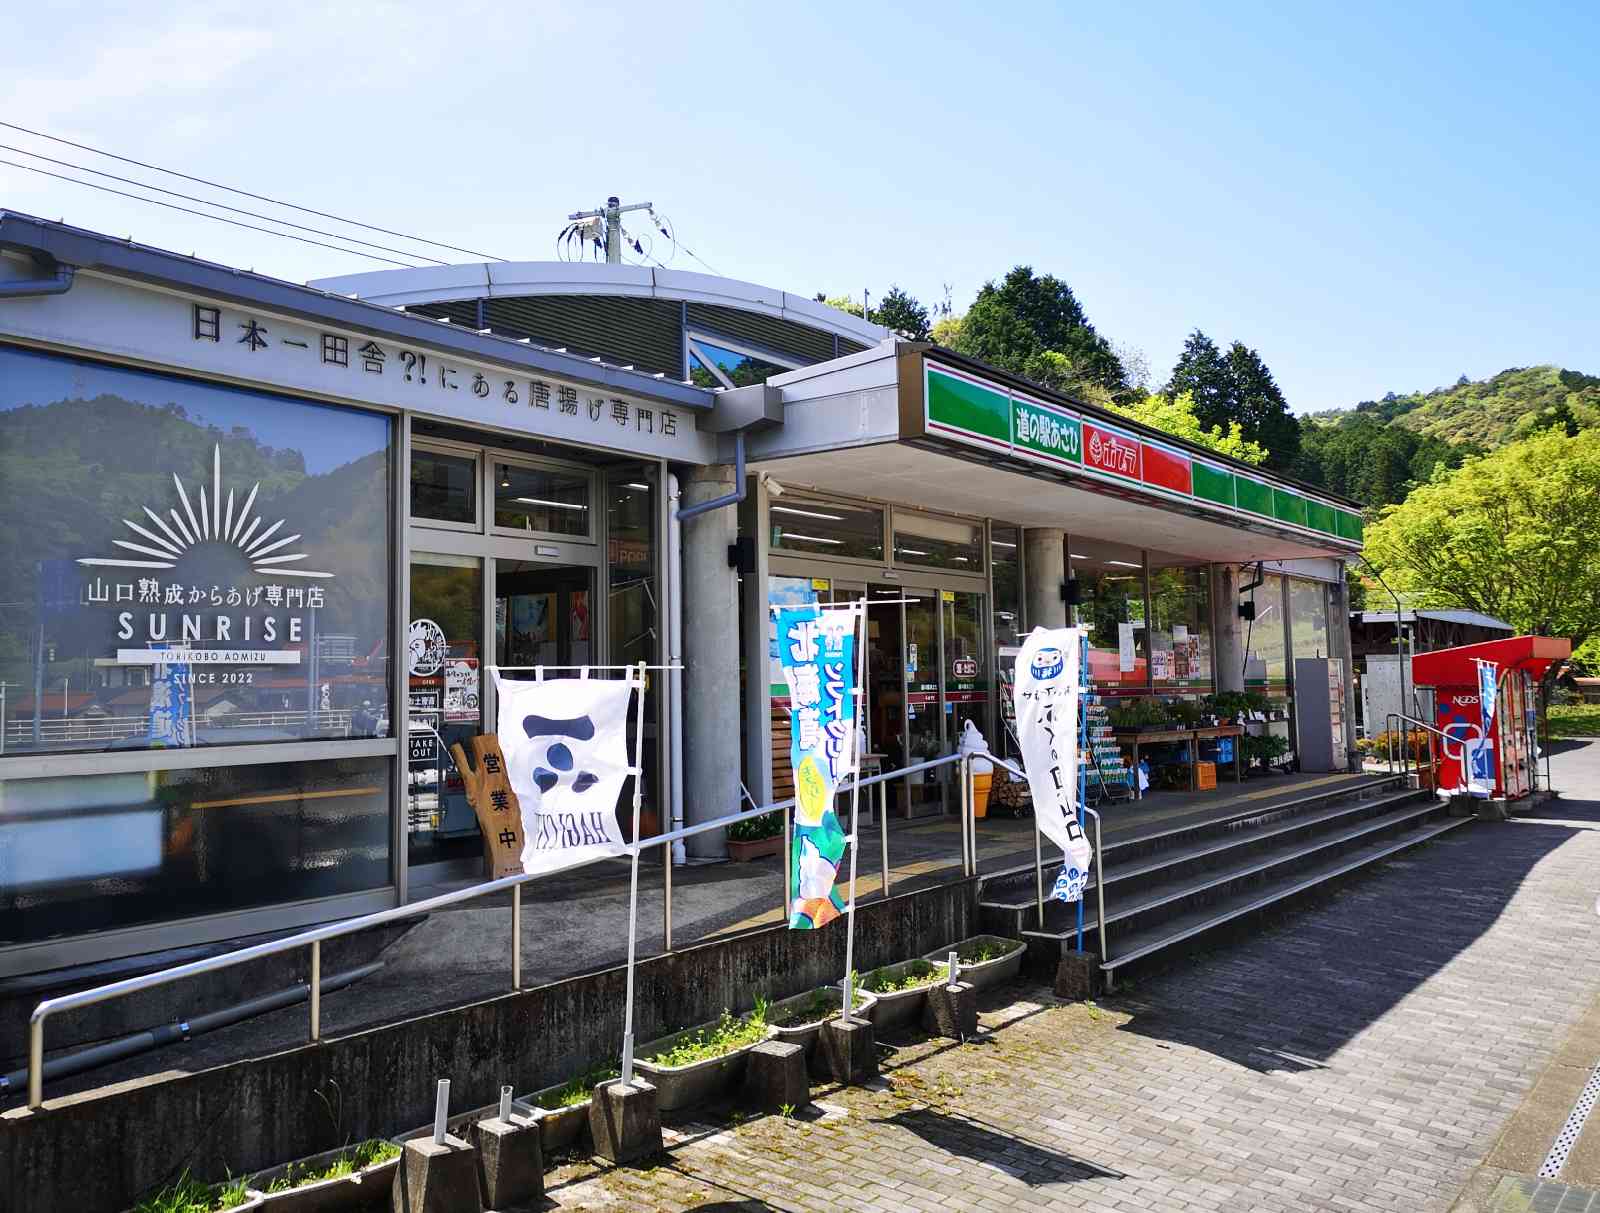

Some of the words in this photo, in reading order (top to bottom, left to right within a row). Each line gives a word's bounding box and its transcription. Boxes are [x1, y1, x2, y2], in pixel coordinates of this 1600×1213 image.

[1016, 407, 1079, 455] 道の駅あさひ
[1103, 437, 1137, 474] ポプラ
[88, 577, 325, 609] 山口熟成からあげ専門店
[118, 611, 302, 642] SUNRISE
[225, 652, 266, 662] AOMIZU
[174, 673, 215, 684] SINCE
[222, 673, 253, 684] 2022
[409, 739, 433, 749] TAKE
[412, 748, 432, 758] OUT
[483, 752, 517, 849] 営業中
